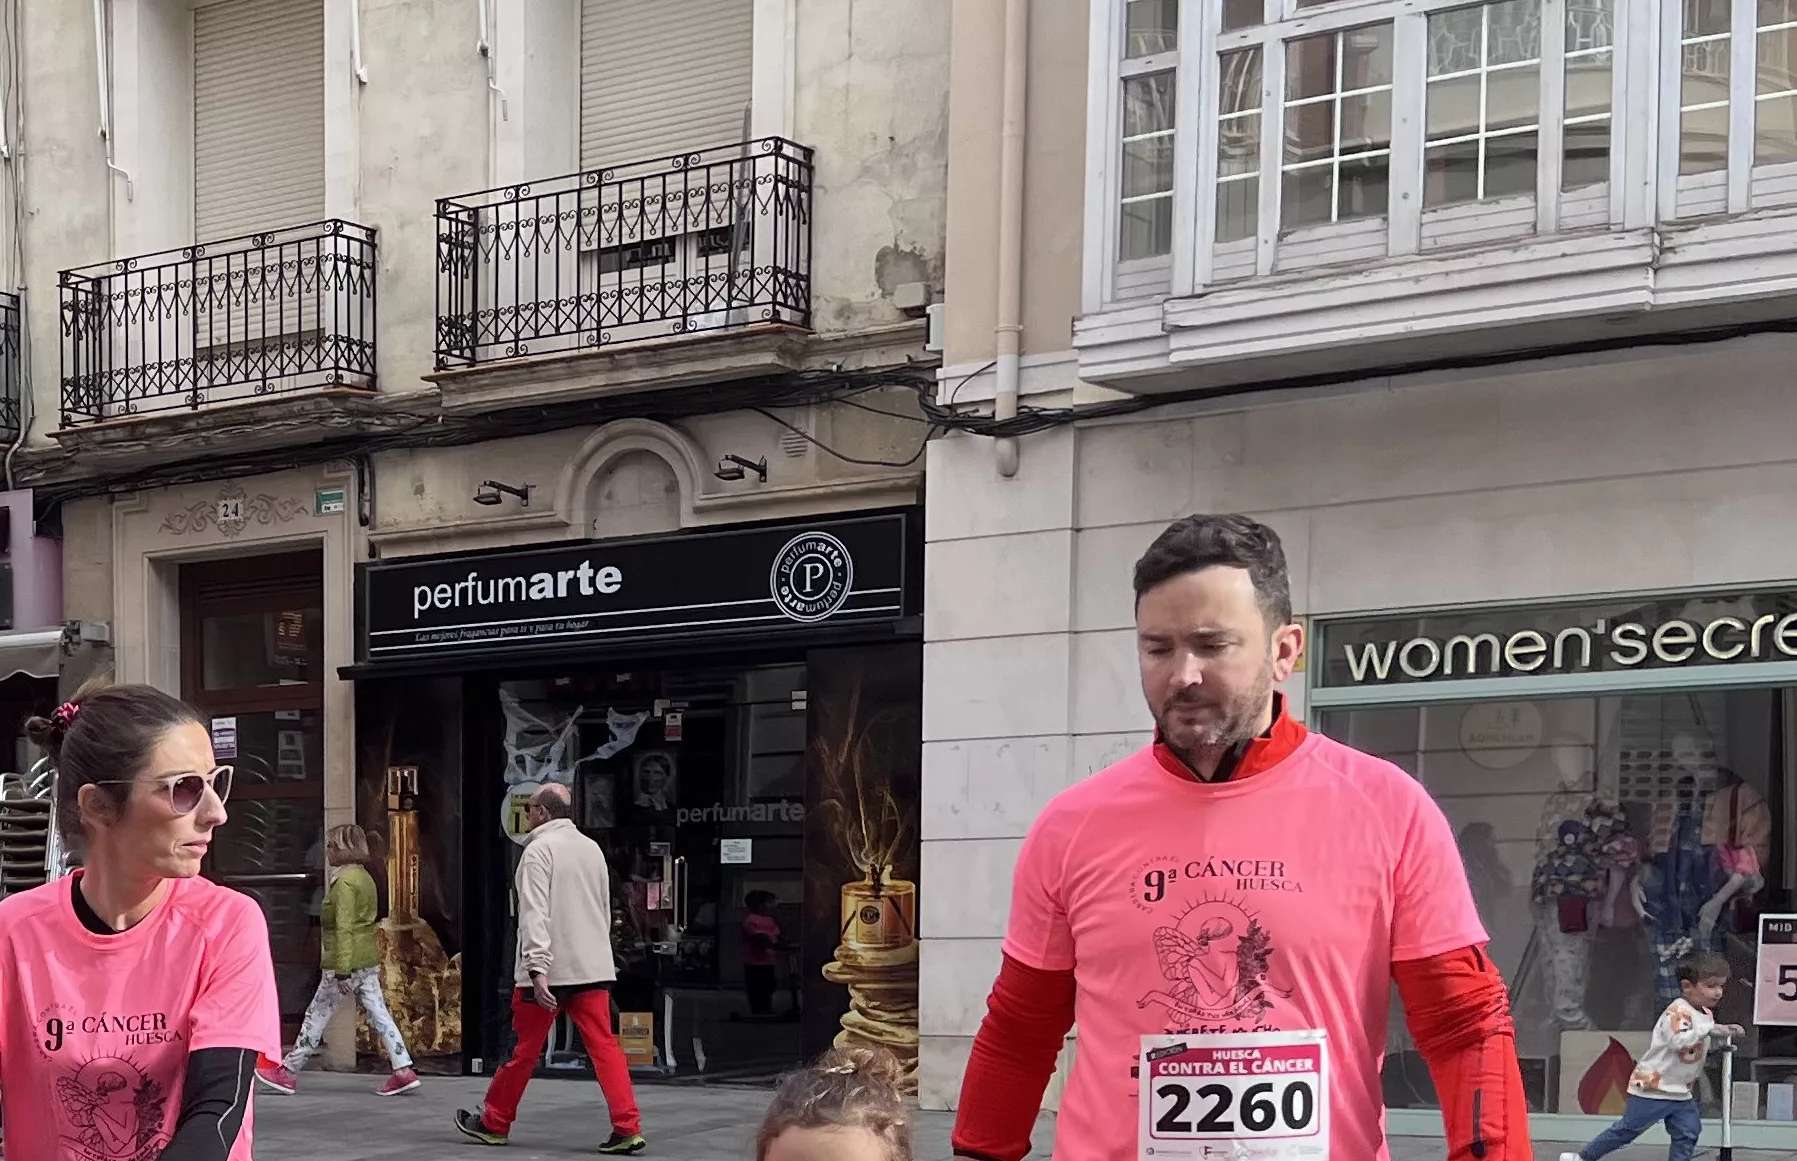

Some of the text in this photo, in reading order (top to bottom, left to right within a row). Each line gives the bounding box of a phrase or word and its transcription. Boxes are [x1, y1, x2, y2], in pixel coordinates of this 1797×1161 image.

[222, 503, 238, 517] 24
[803, 563, 824, 592] P
[413, 560, 623, 618] perfumarte
[676, 799, 804, 828] perfumarte
[1184, 856, 1285, 879] CÁNCER
[1236, 878, 1304, 893] HUESCA
[81, 1012, 167, 1034] CÁNCER
[125, 1030, 183, 1046] HUESCA
[1158, 1057, 1314, 1075] CONTRA EL CÁNCER
[1212, 1050, 1261, 1060] HUESCA
[1155, 1080, 1315, 1134] 2260
